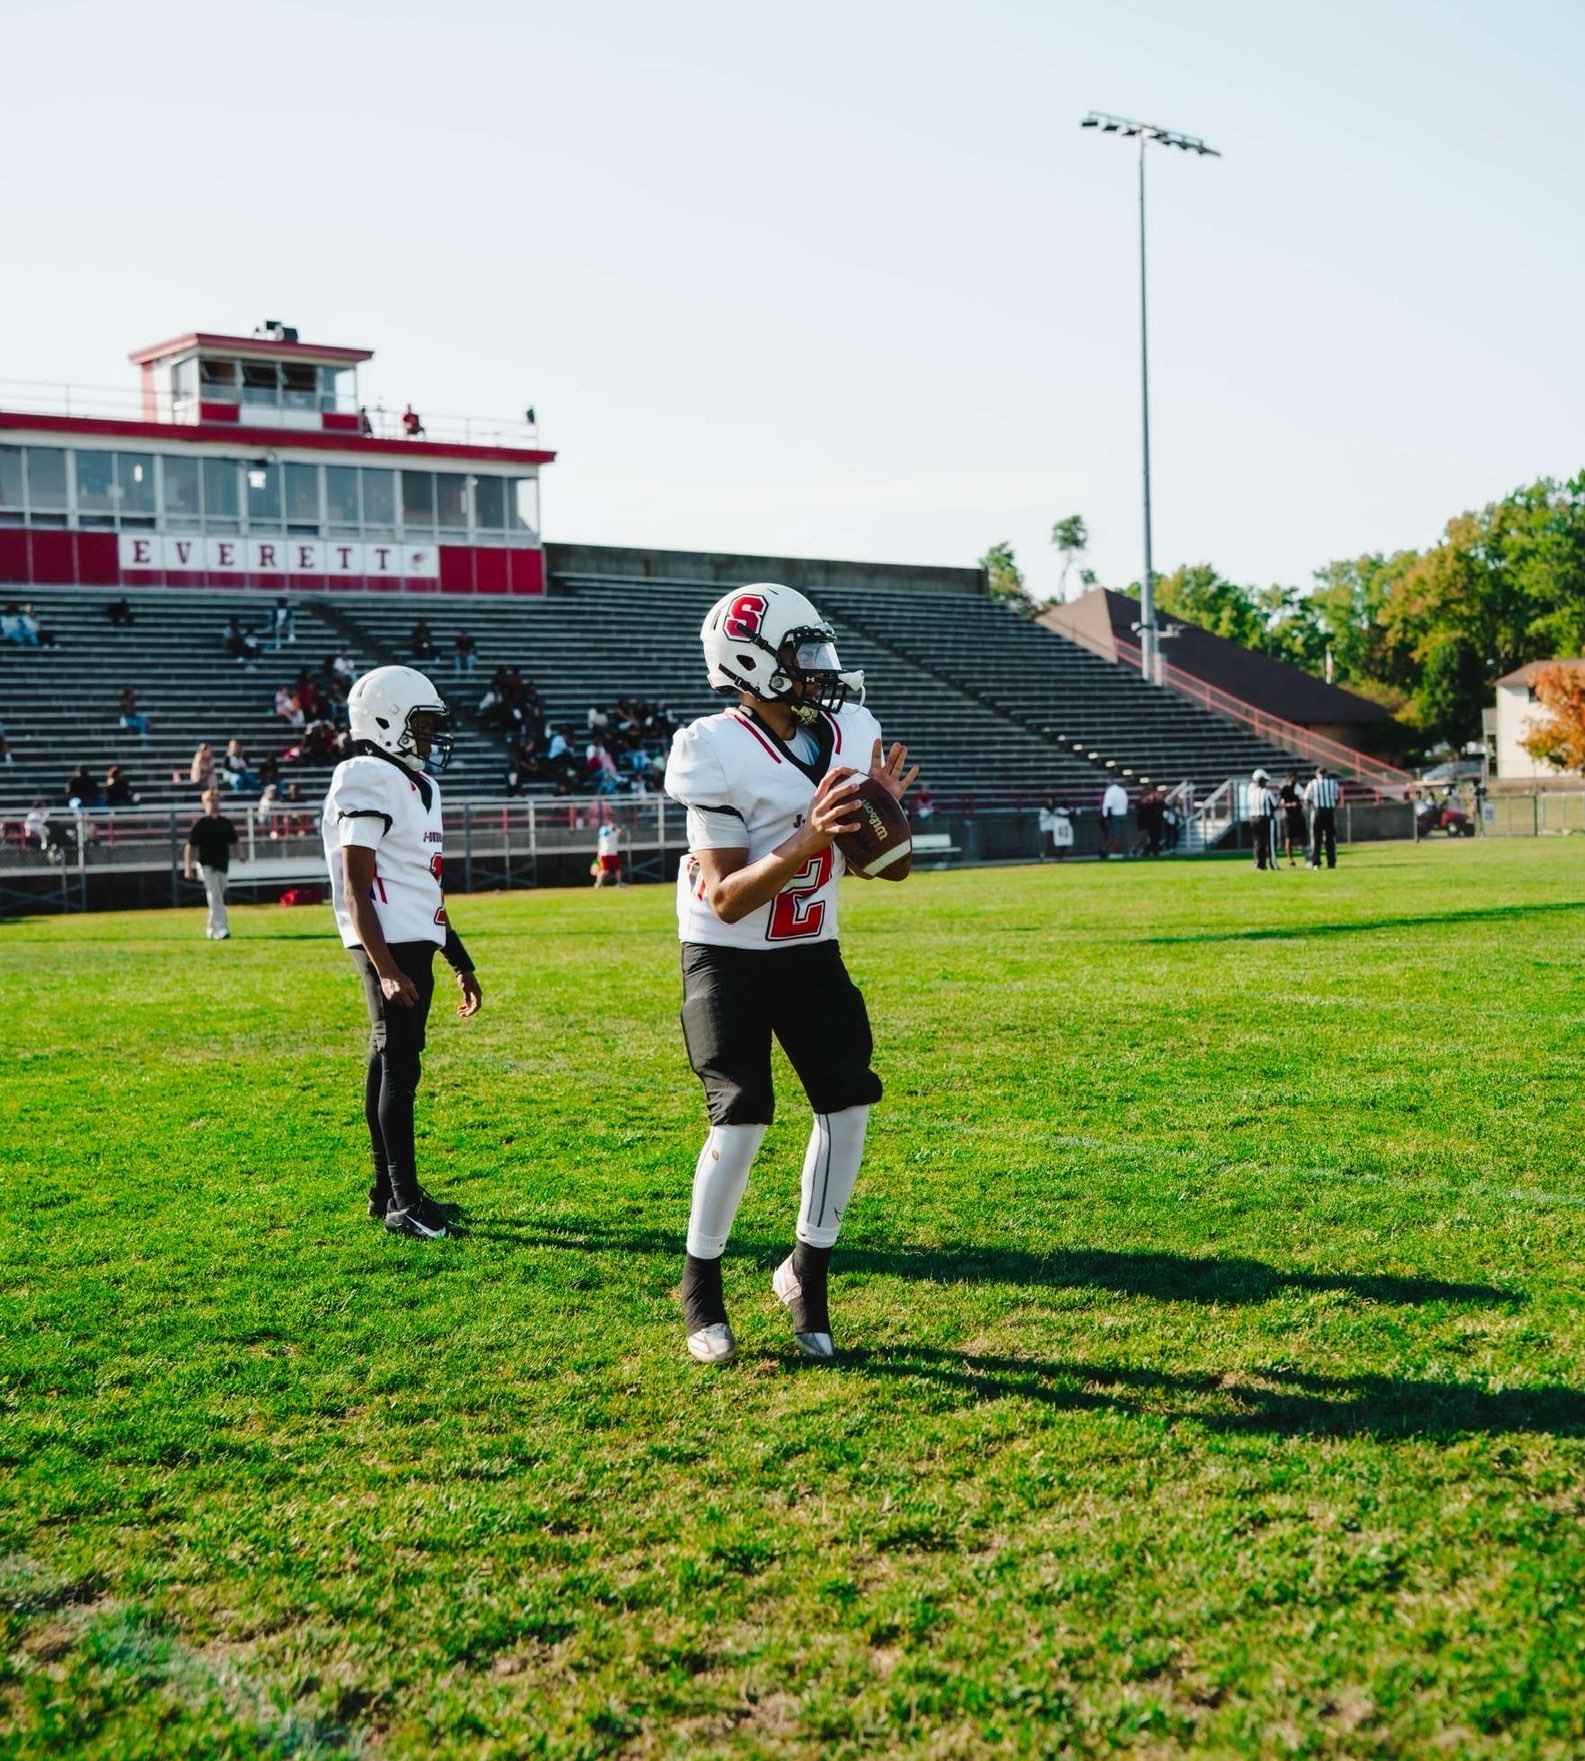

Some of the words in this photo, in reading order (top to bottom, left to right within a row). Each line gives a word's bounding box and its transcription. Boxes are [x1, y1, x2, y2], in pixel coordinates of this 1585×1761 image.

[133, 540, 391, 570] EVERETT
[723, 593, 769, 643] S
[765, 842, 835, 941] 2
